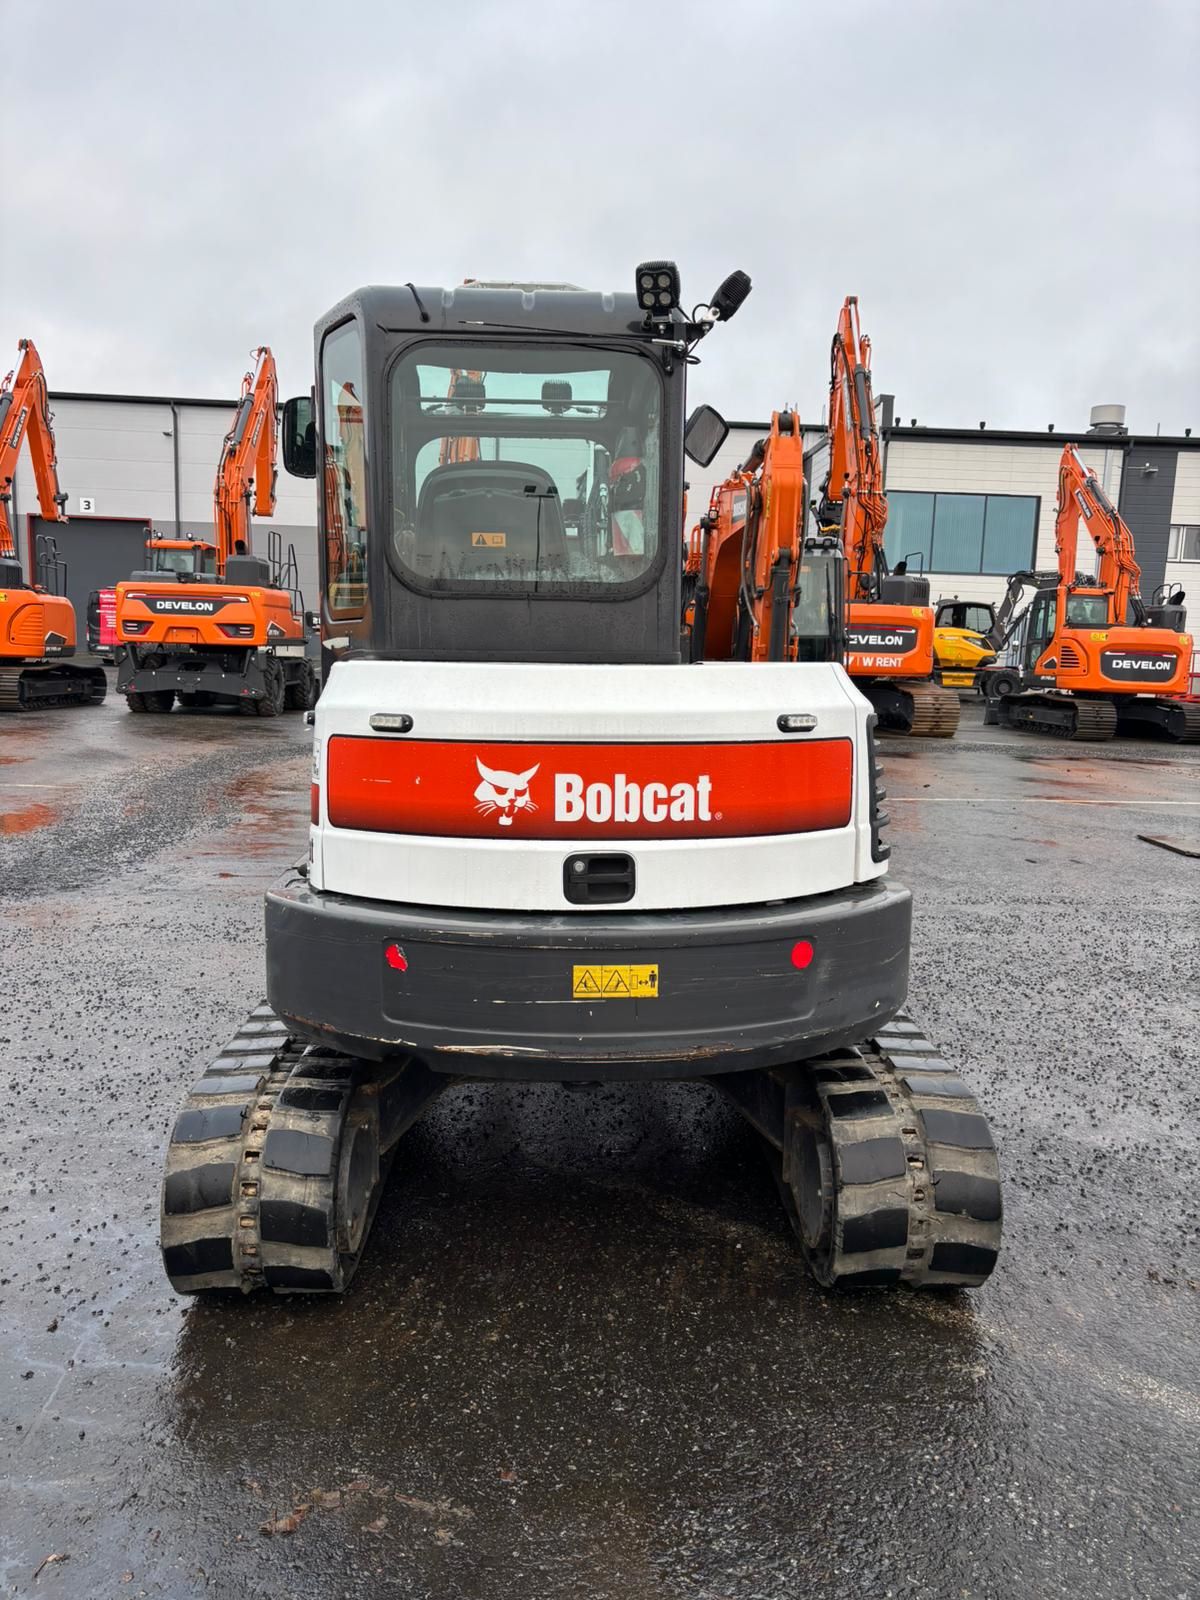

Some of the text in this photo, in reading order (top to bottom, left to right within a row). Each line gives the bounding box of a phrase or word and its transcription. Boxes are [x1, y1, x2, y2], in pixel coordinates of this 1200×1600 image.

[83, 500, 91, 510] 3
[156, 601, 213, 611] DEVELON
[849, 634, 903, 646] EVELON
[862, 656, 874, 667] W
[876, 657, 904, 667] RENT
[1111, 659, 1171, 671] DEVELON
[554, 773, 712, 823] Bobcat
